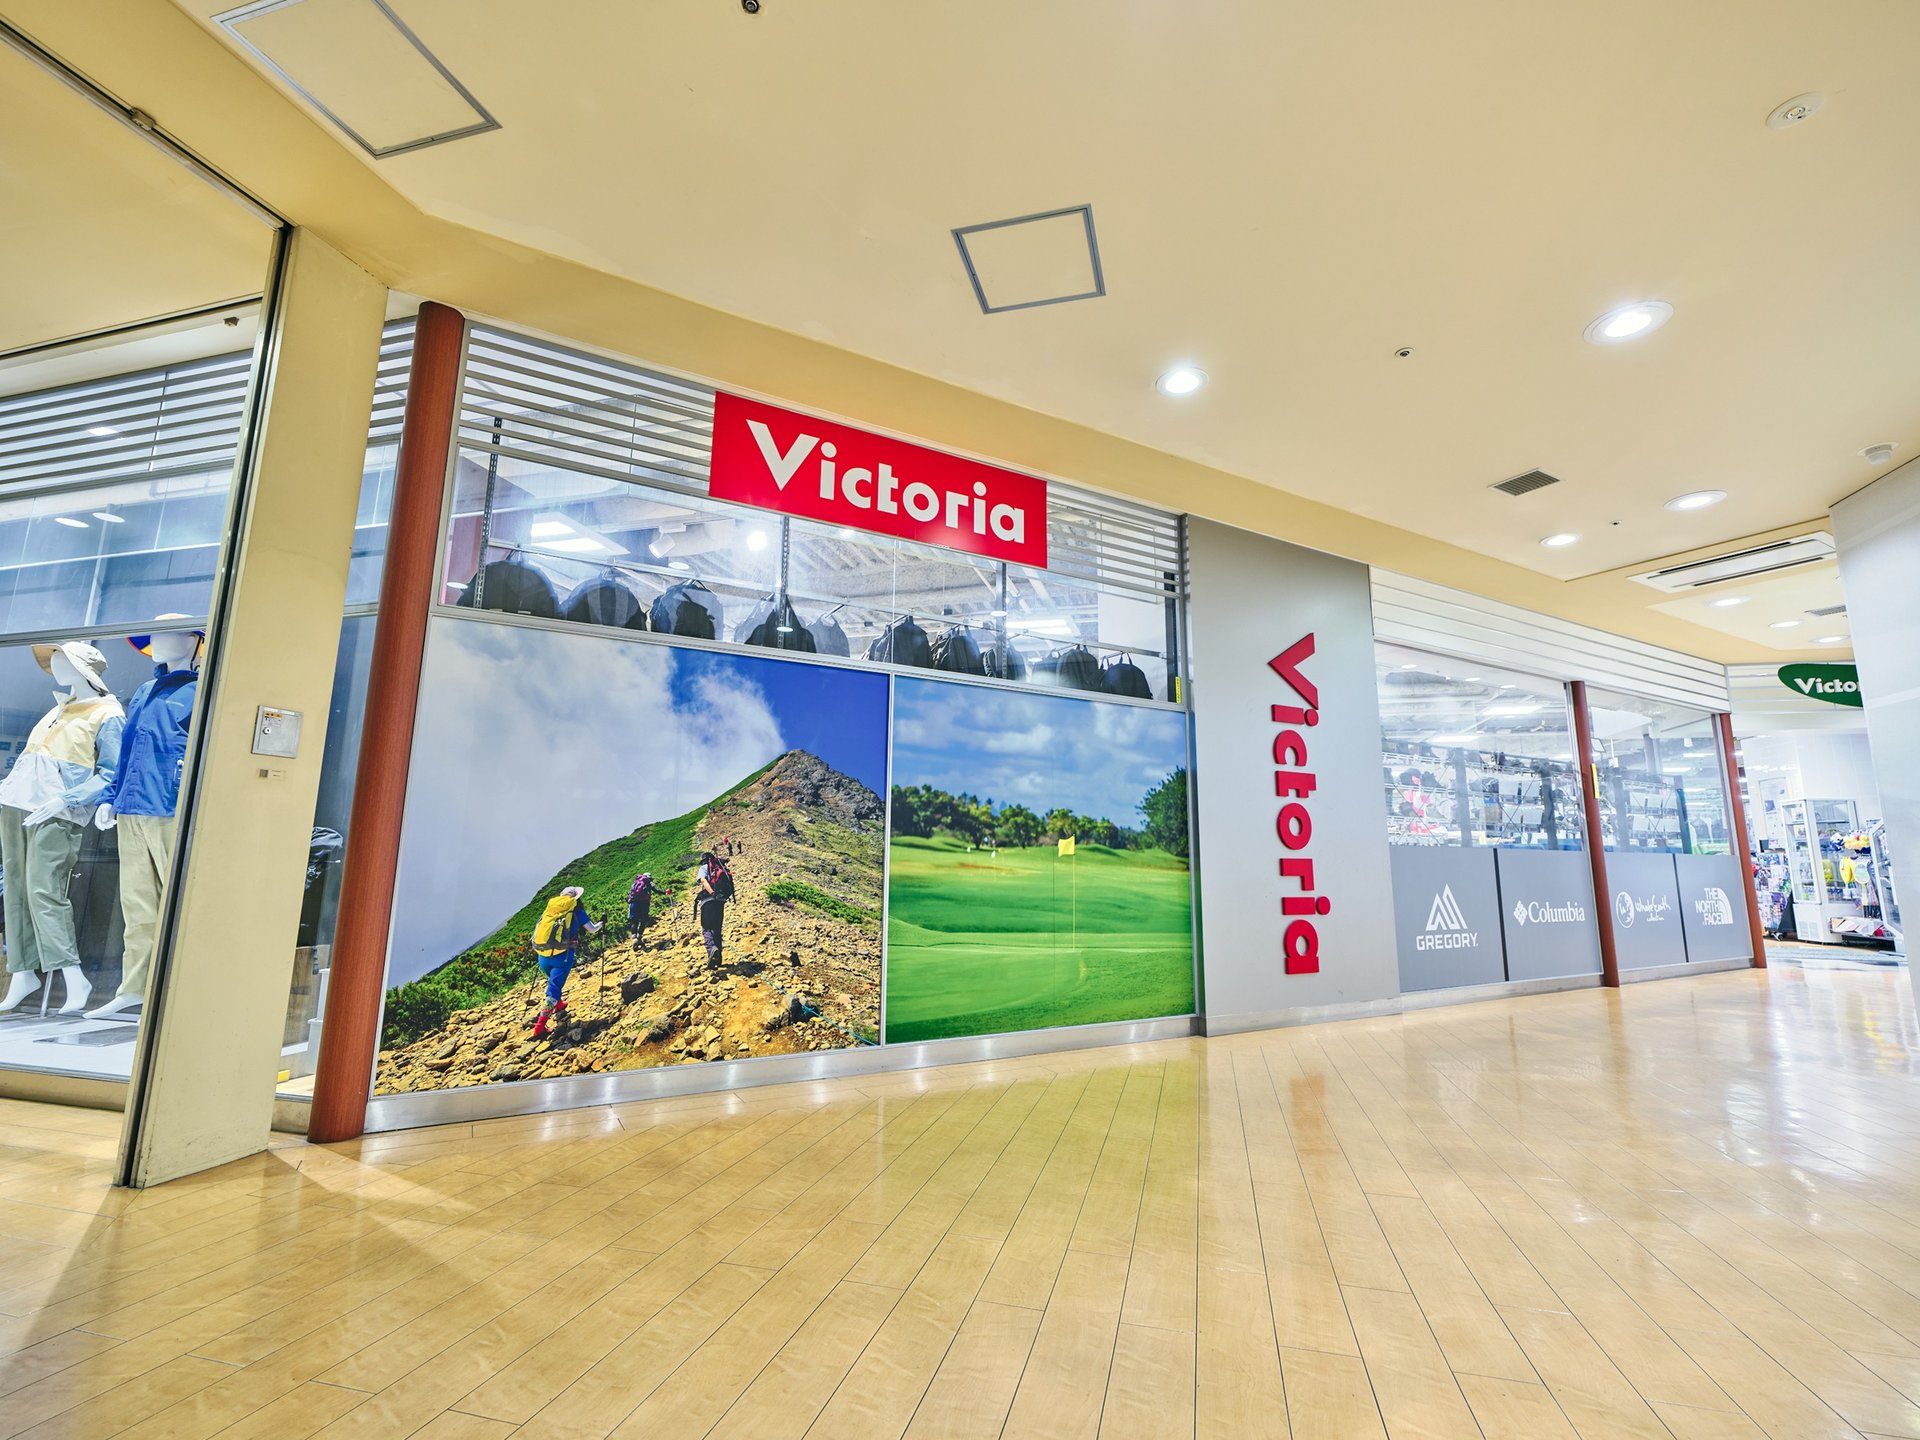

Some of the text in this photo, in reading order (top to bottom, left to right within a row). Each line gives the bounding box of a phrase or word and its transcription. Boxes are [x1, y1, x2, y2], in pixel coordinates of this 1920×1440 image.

[746, 419, 1025, 544] Victoria
[1268, 632, 1331, 975] Victoria
[1703, 887, 1719, 900] THE
[1528, 901, 1586, 923] Columbia
[1695, 900, 1720, 913] NORTH
[1704, 912, 1722, 925] FACE
[1416, 933, 1478, 950] GREGORY
